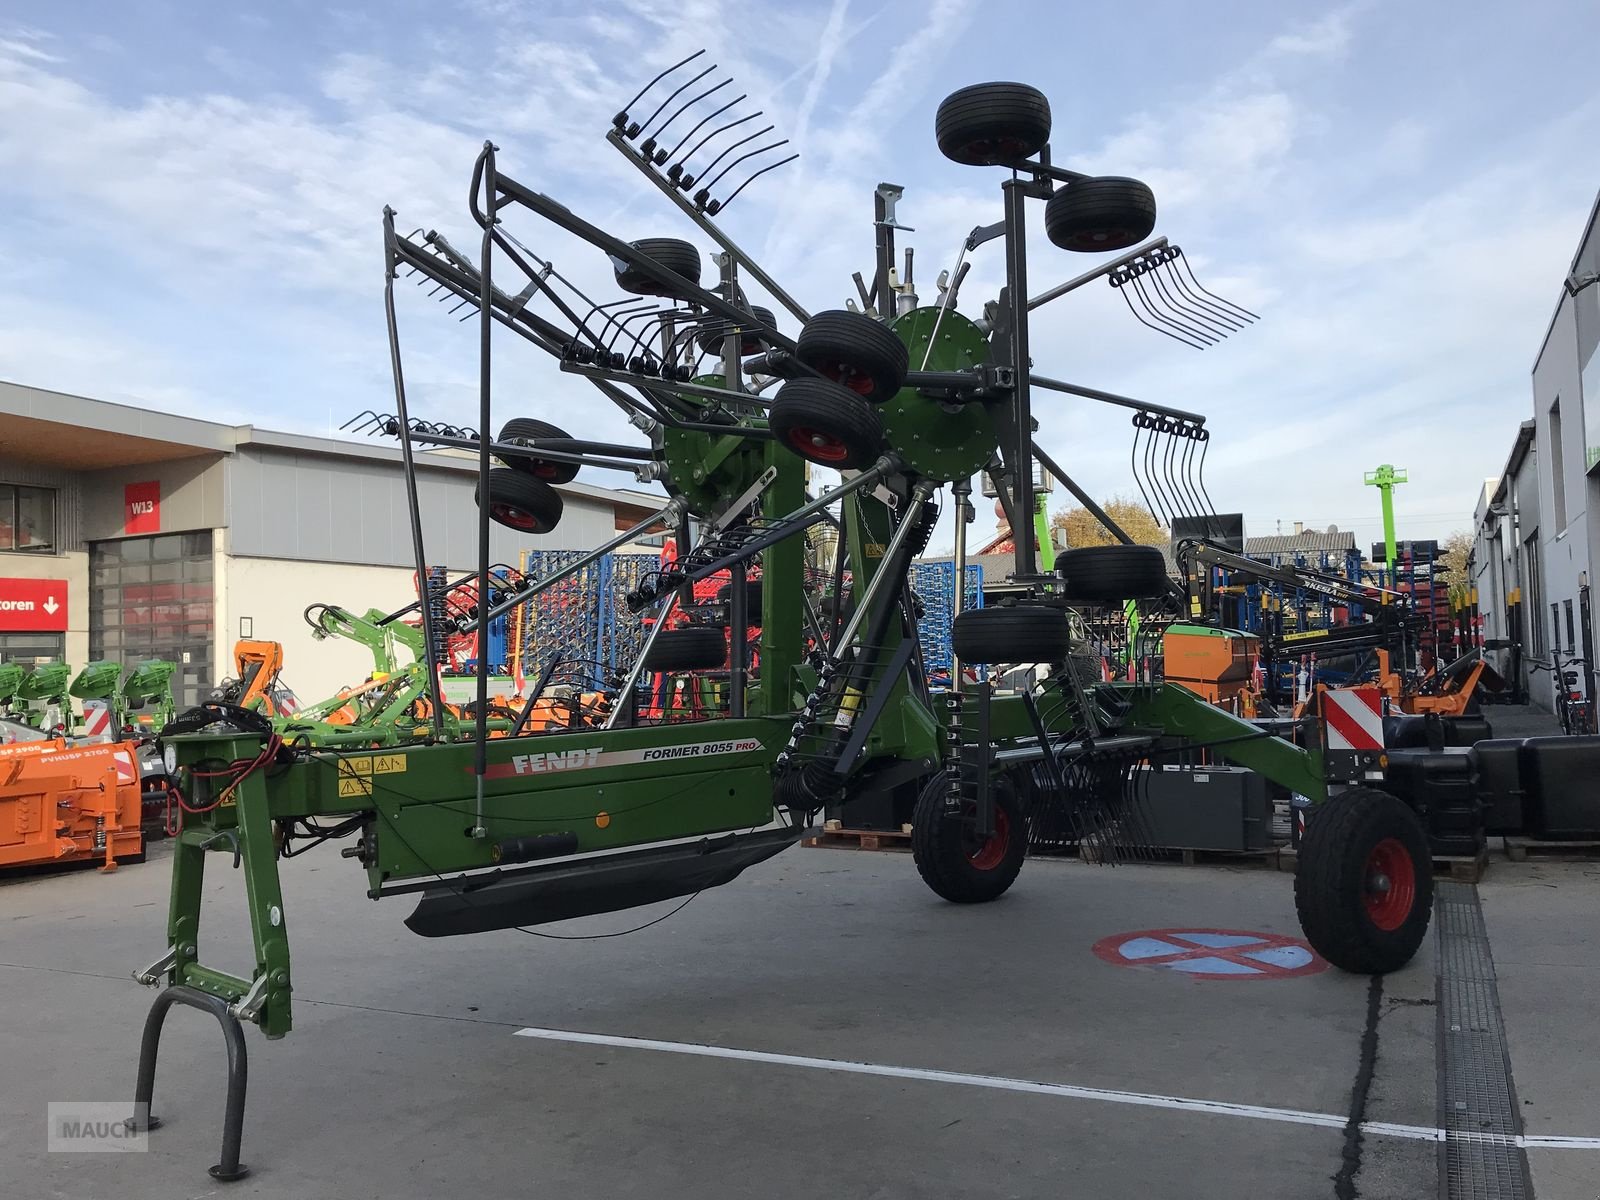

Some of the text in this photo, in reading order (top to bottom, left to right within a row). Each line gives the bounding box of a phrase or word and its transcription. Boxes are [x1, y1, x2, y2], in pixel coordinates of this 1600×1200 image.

[131, 500, 153, 515] W13
[15, 745, 41, 754] 2900
[83, 748, 110, 758] 2700
[512, 742, 756, 774] FENDT FORMER 8055 PRO
